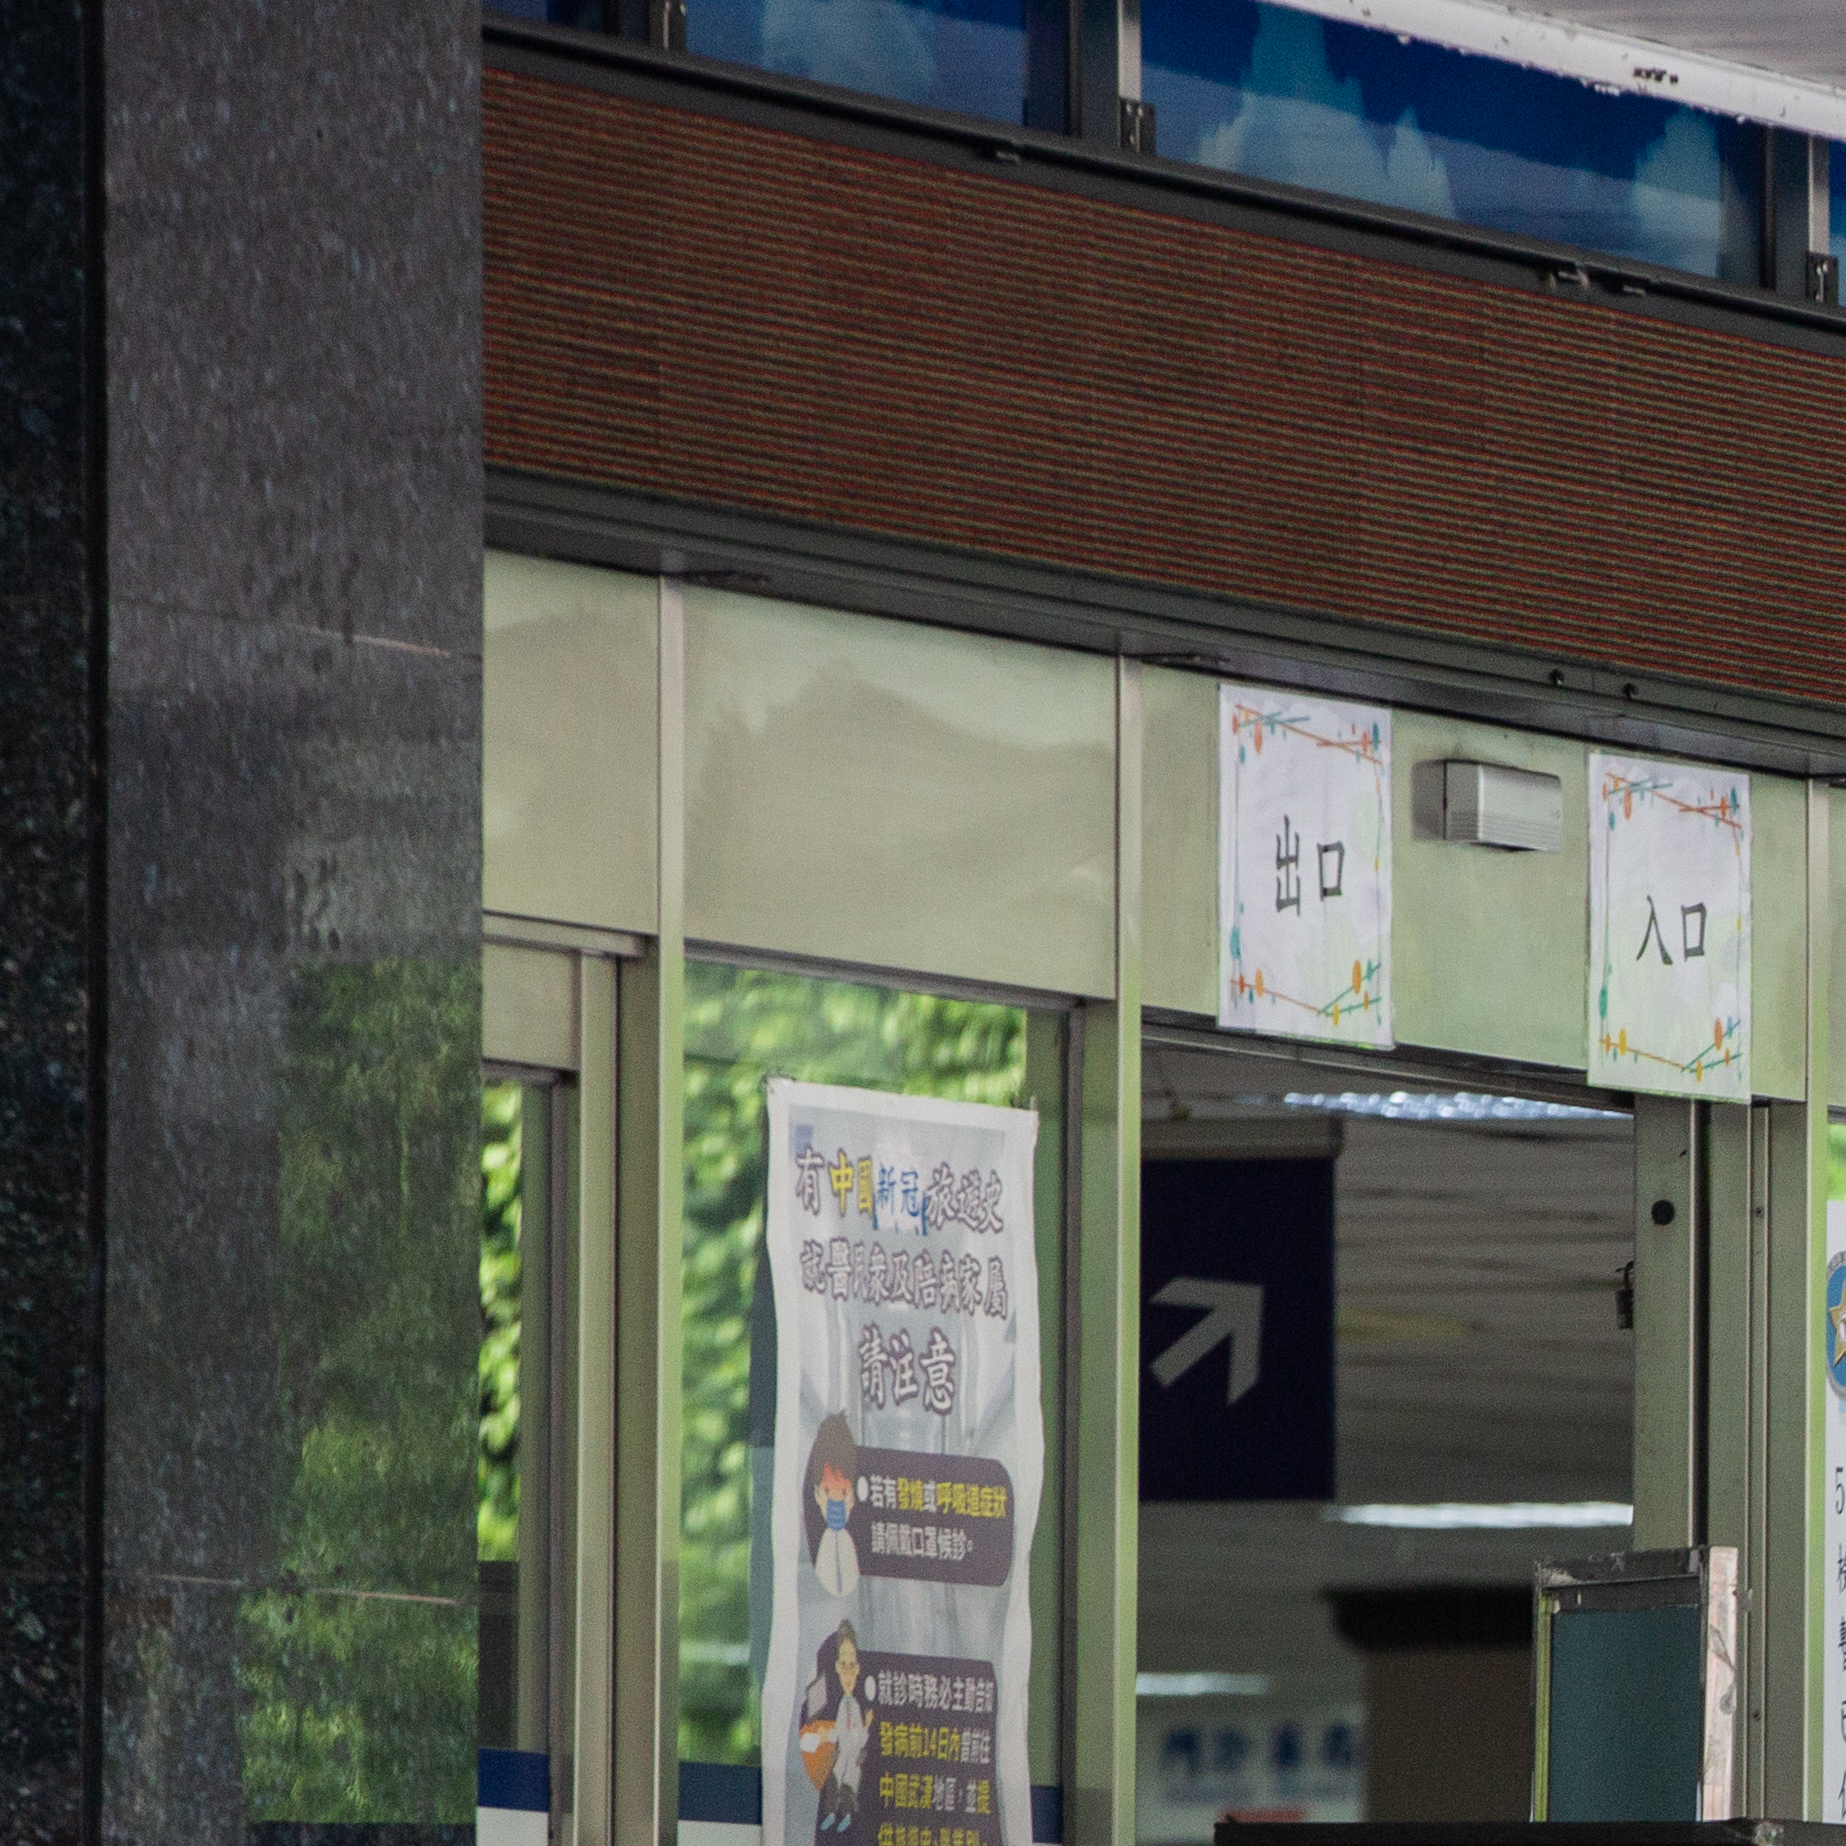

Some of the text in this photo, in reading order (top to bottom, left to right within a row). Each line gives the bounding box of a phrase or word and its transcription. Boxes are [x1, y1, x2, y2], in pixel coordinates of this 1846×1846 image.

[1275, 814, 1345, 917] 出口
[1636, 894, 1708, 966] 入口
[857, 1320, 956, 1416] 請注意
